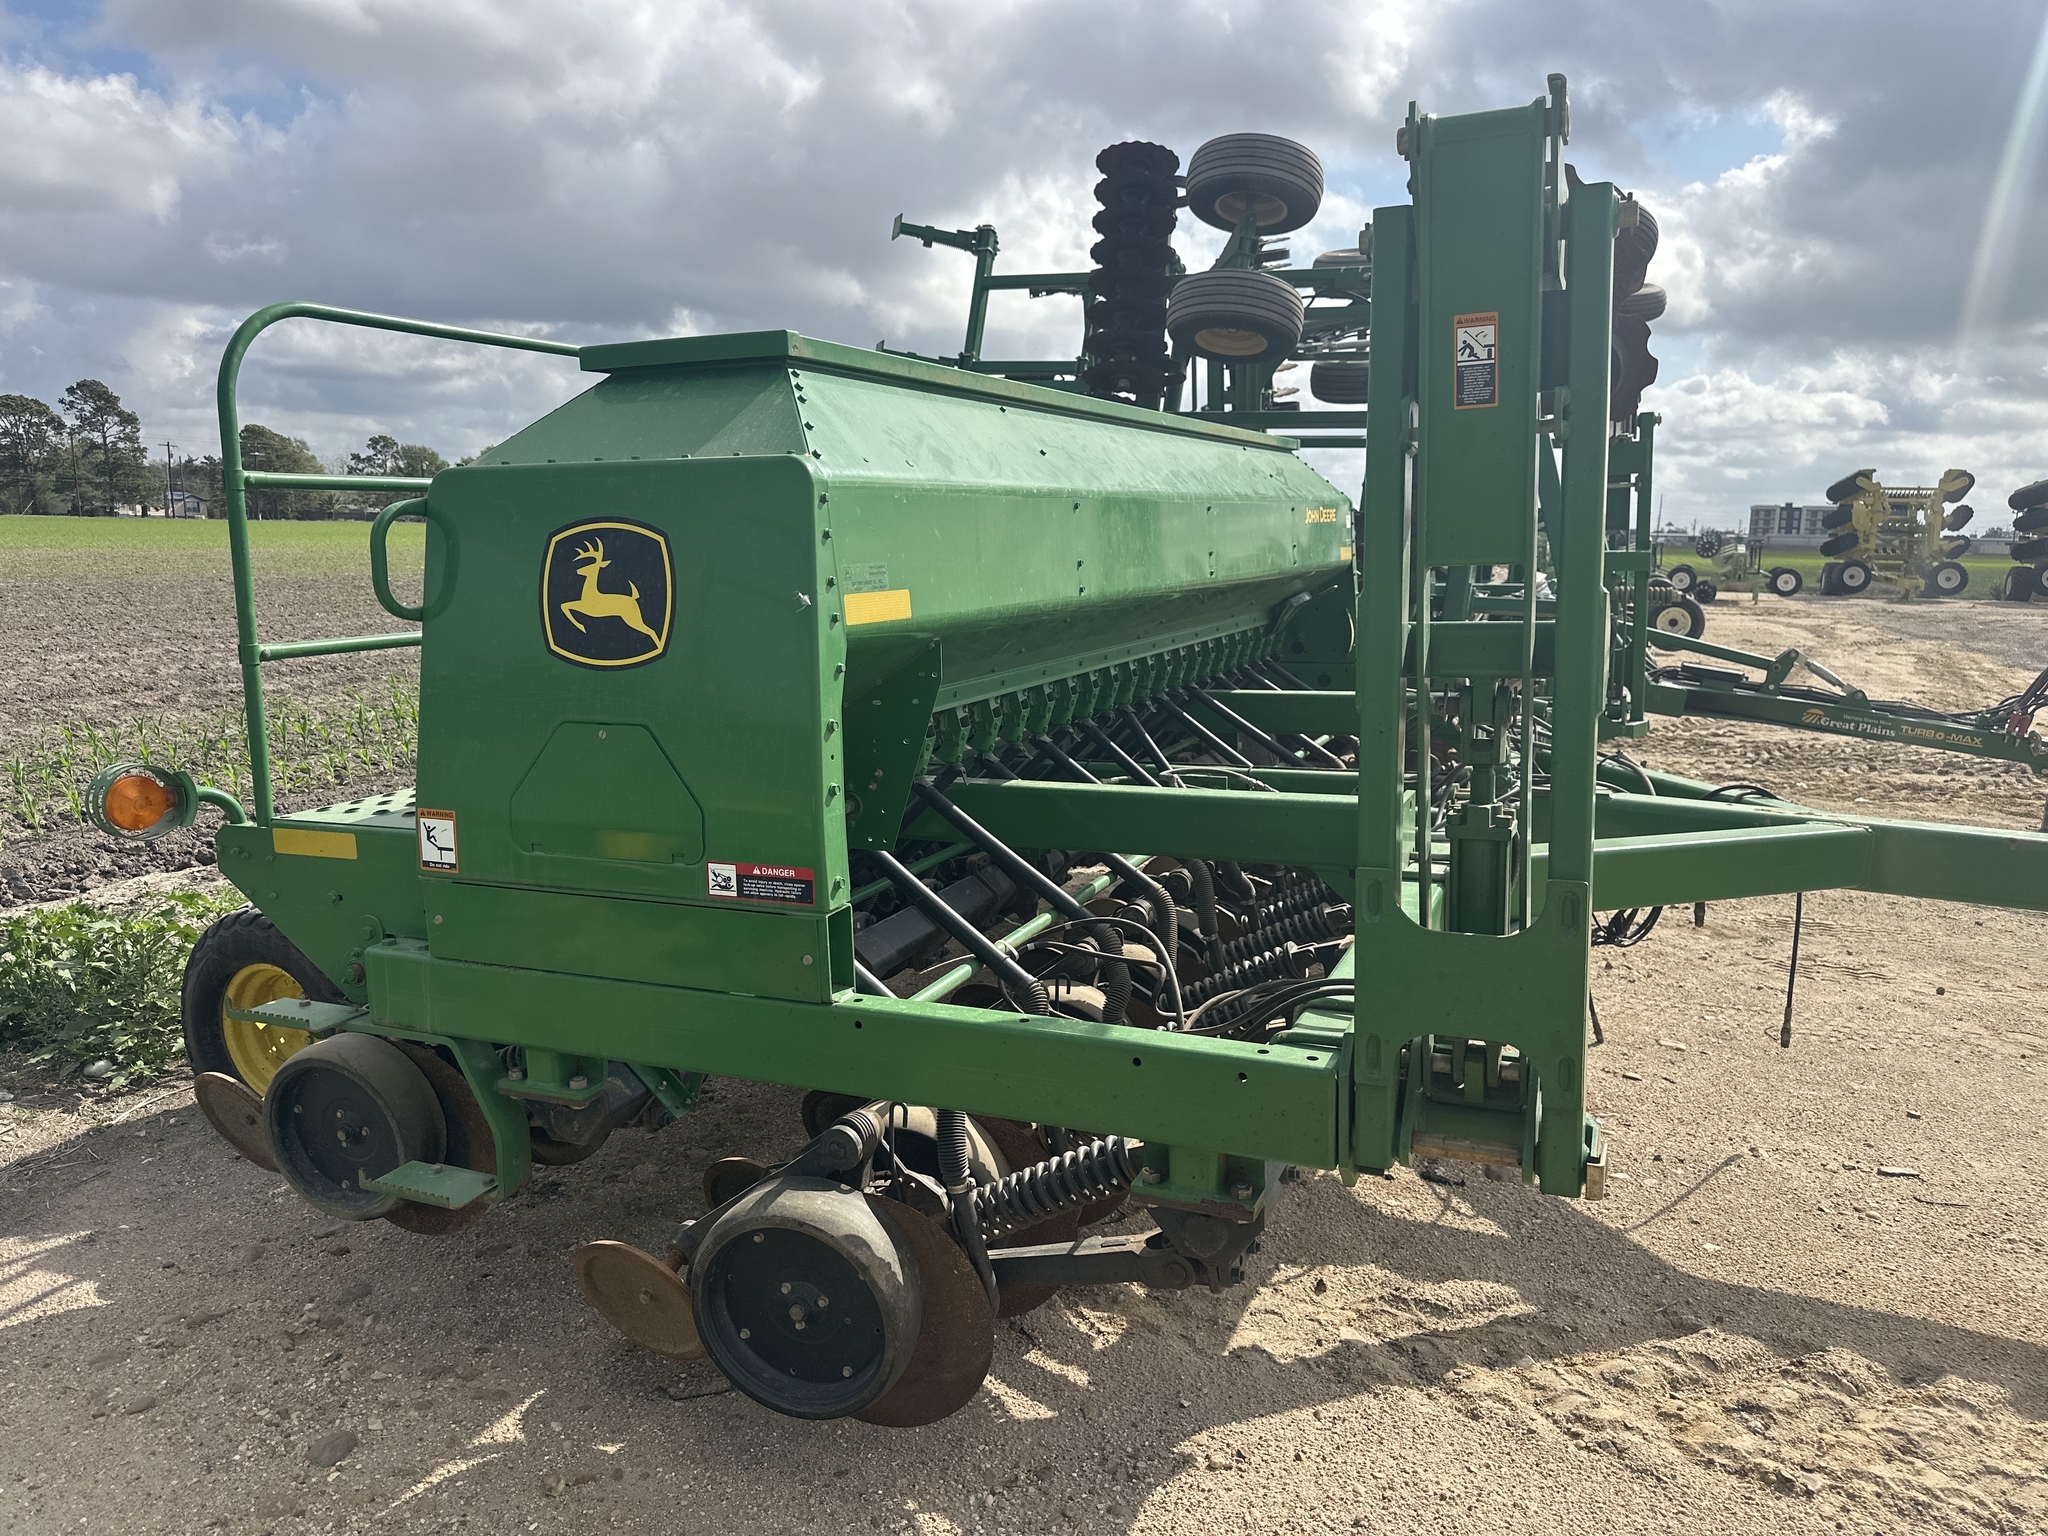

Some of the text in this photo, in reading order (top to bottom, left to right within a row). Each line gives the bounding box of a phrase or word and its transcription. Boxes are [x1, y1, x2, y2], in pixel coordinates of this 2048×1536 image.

[1463, 315, 1496, 324] WARNING
[1305, 506, 1336, 524] JOHN DEERE
[1820, 717, 1896, 737] Great Plains
[761, 867, 796, 877] DANGER
